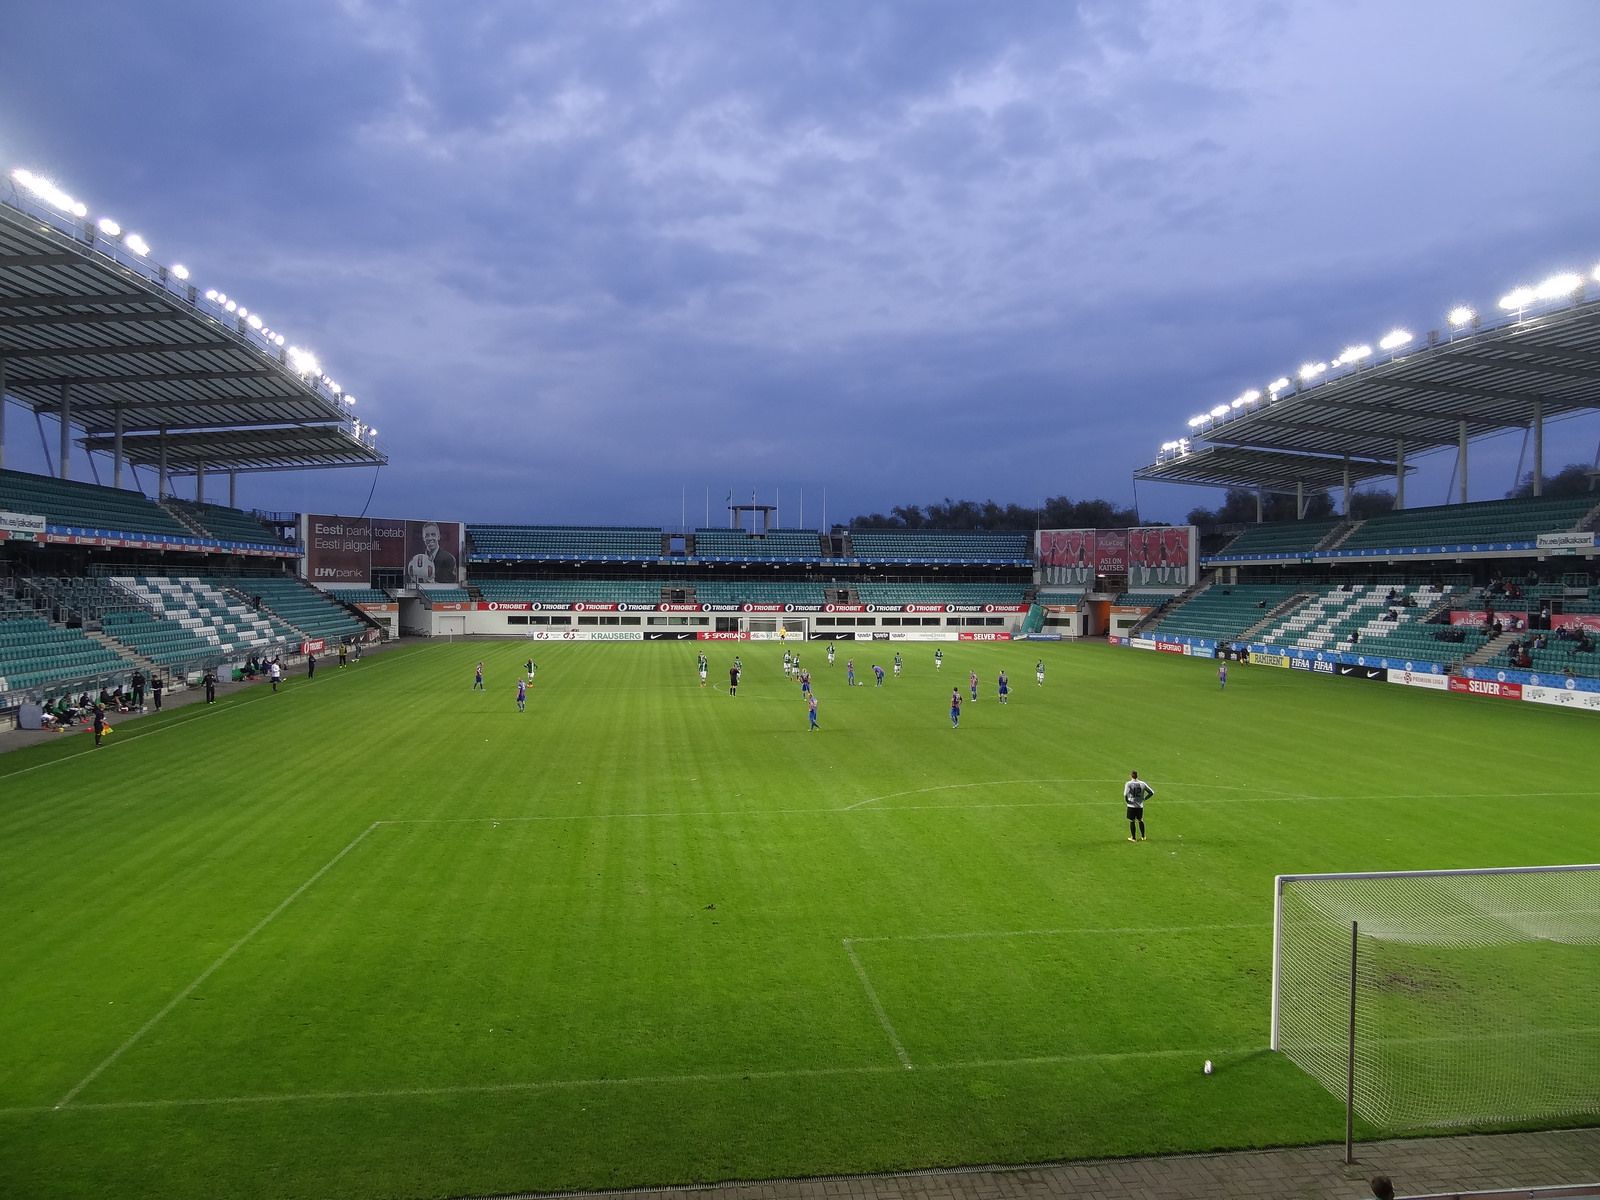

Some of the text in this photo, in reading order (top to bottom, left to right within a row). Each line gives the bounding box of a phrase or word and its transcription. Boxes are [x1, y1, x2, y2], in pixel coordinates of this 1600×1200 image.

[315, 523, 343, 535] Eesti
[346, 526, 371, 537] pank
[314, 537, 340, 549] Eesti
[973, 633, 996, 641] SELVER
[1254, 654, 1284, 666] RAMIRENT
[1291, 657, 1310, 668] FIFAA
[1313, 660, 1333, 672] FIFAA
[1468, 680, 1500, 696] SELVER
